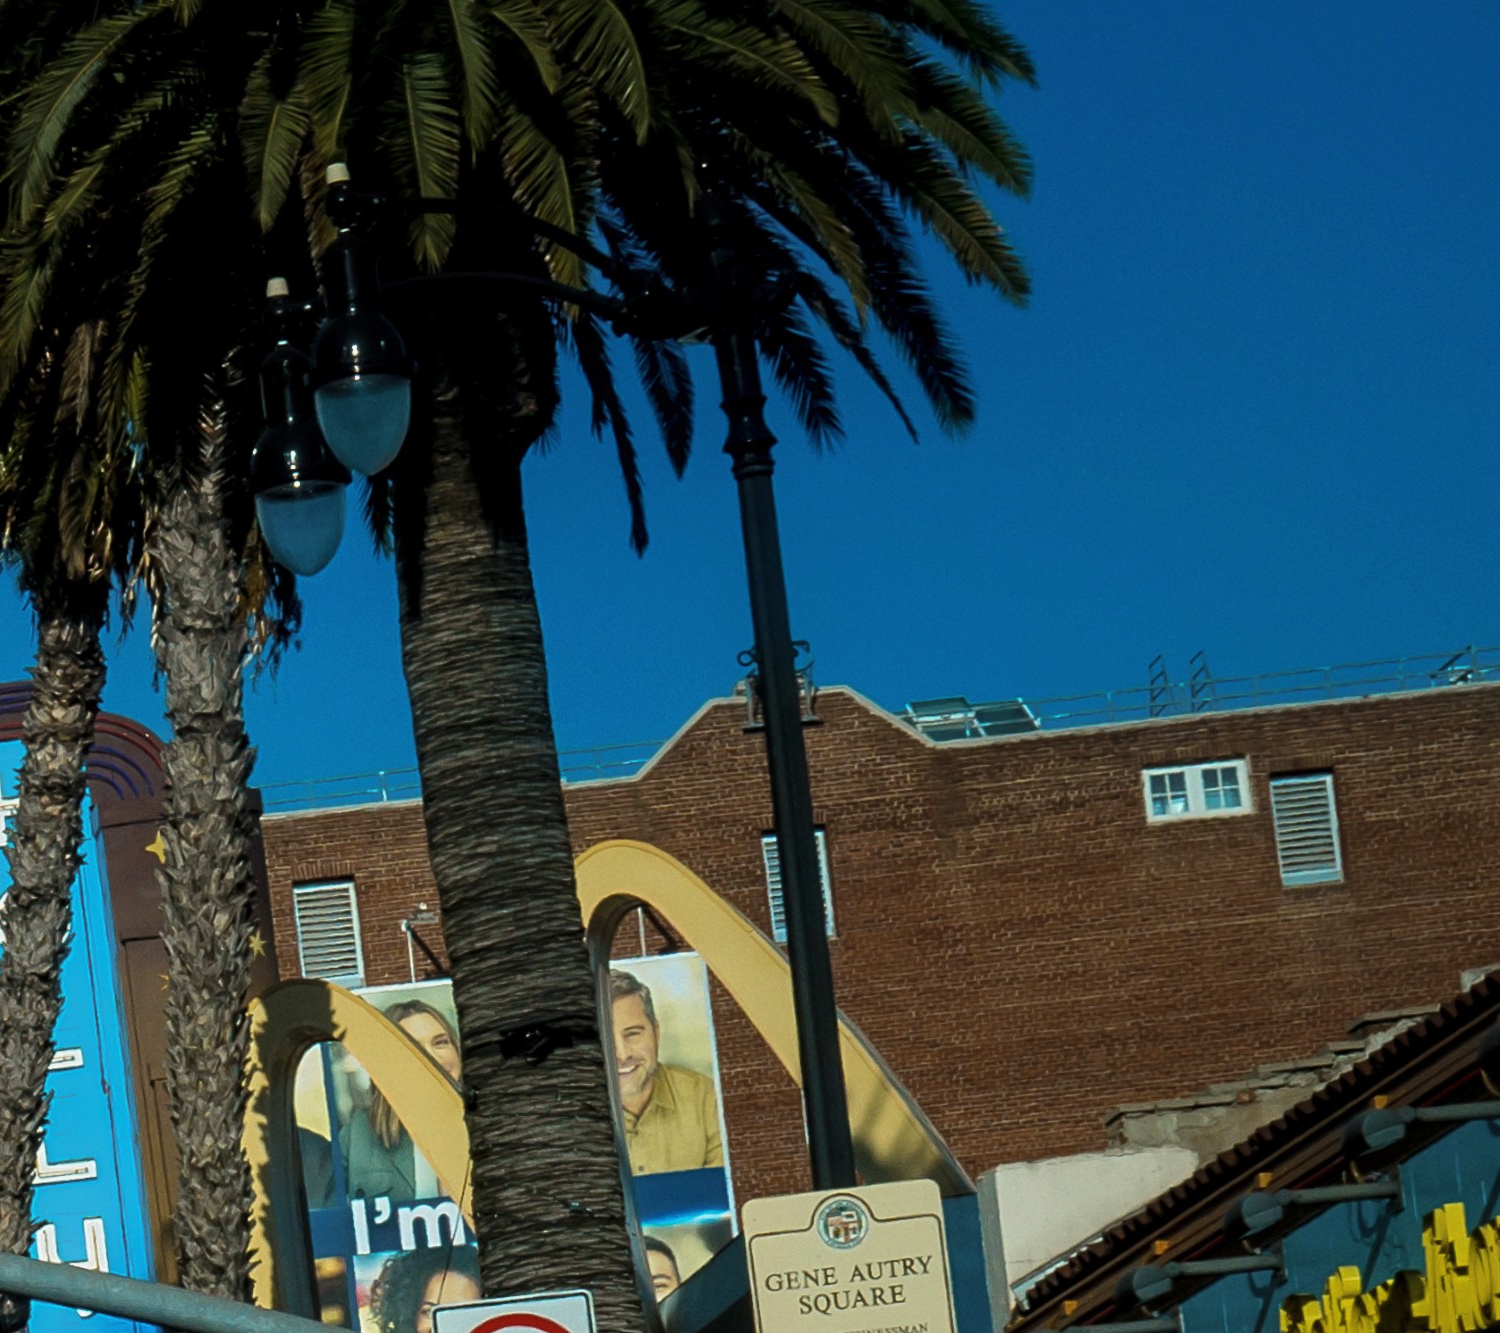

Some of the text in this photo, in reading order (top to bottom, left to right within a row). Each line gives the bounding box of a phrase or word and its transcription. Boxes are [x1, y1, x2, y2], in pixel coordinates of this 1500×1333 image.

[764, 1254, 933, 1292] GENE AUTRY
[799, 1284, 906, 1316] SQUARE
